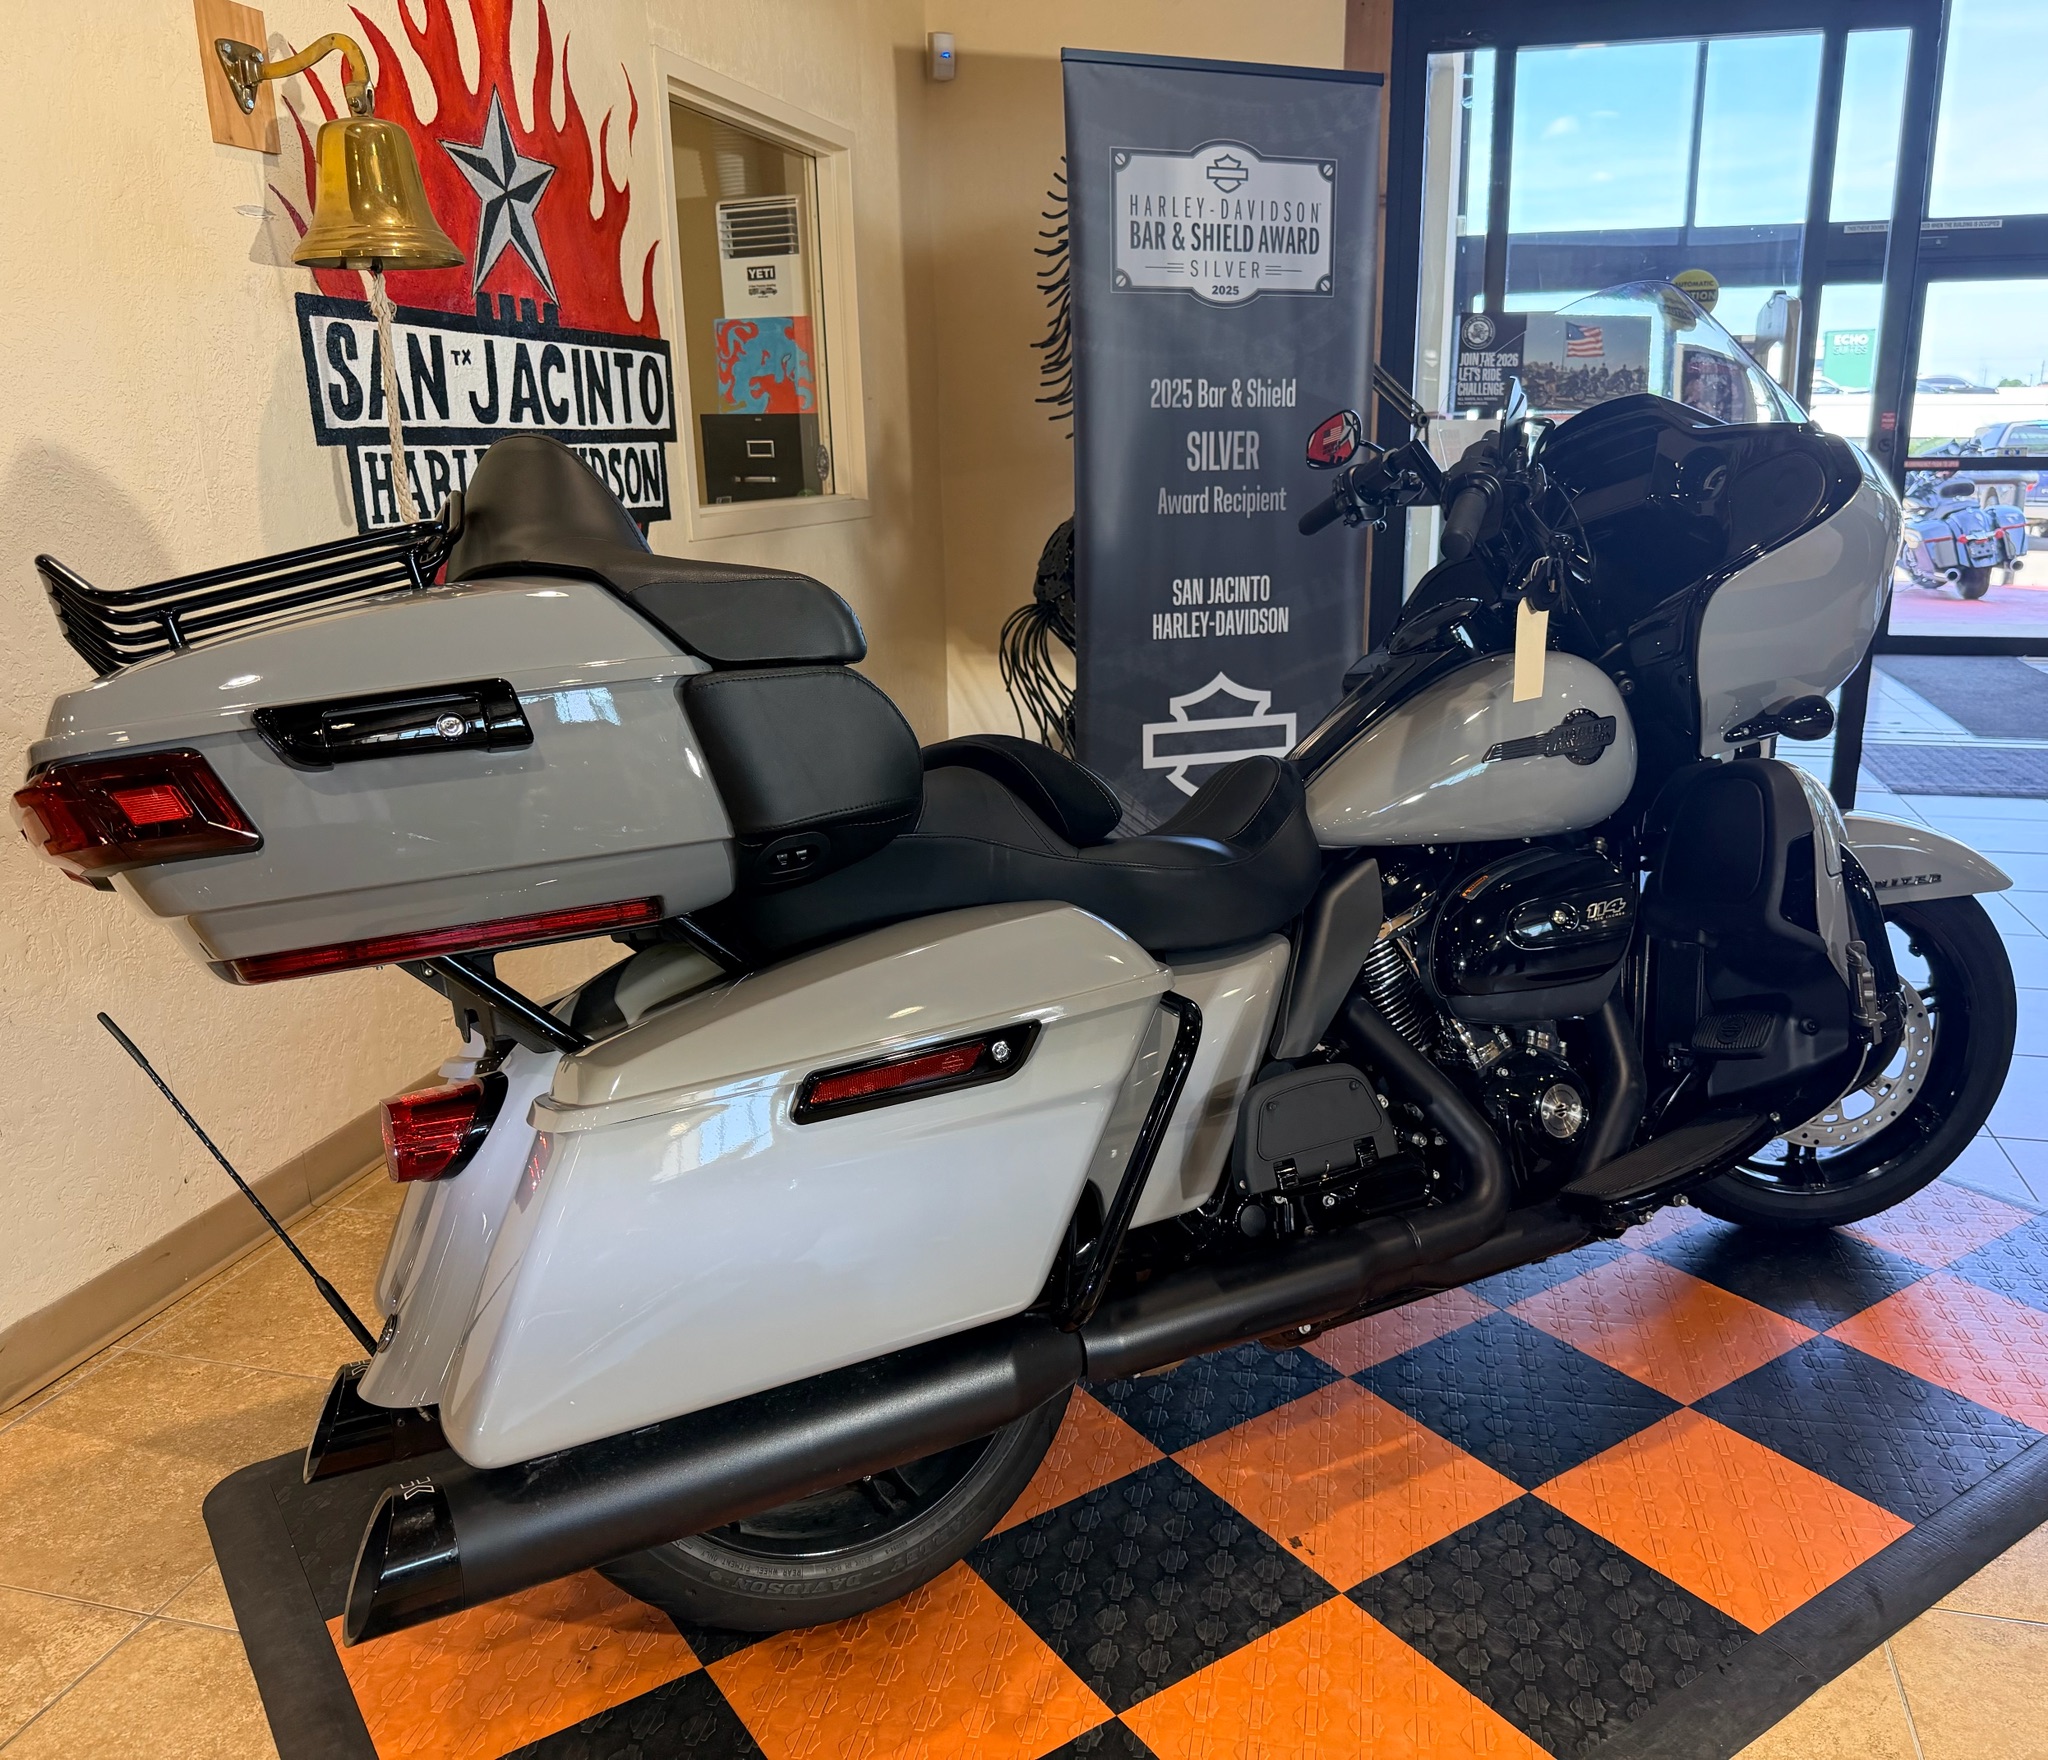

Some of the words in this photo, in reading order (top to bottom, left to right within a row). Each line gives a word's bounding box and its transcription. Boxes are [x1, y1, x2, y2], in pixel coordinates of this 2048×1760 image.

[1130, 194, 1320, 223] HARLEY-DAVIDSON
[1130, 220, 1166, 250] BAR
[1172, 221, 1186, 251] &
[1190, 222, 1254, 253] SHIELD
[1258, 225, 1320, 255] AWARD
[748, 268, 774, 279] YETI
[1190, 259, 1260, 278] SILVER
[1211, 285, 1240, 295] 2025
[1675, 280, 1715, 288] AUTOMATIC
[1687, 290, 1717, 301] TION
[1833, 333, 1869, 346] ECHO
[1459, 352, 1480, 366] JOIN
[1480, 352, 1496, 367] THE
[1496, 353, 1519, 367] 2026
[326, 321, 450, 422] SAN
[450, 349, 471, 366] TX
[468, 339, 665, 426] JACINTO
[1458, 367, 1481, 381] LET'S
[1482, 368, 1502, 382] RIDE
[1150, 378, 1193, 409] 2025
[1197, 378, 1227, 409] Bar
[1231, 378, 1243, 408] &
[1246, 377, 1297, 408] Shield
[1457, 382, 1505, 396] CHALLENGE
[1186, 430, 1260, 472] SILVER
[1157, 486, 1209, 515] Award
[1213, 485, 1287, 518] Recipient
[1172, 578, 1204, 606] SAN
[1207, 575, 1270, 604] JACINTO
[1152, 606, 1289, 640] HARLEY-DAVIDSON
[1585, 897, 1627, 919] 114
[701, 1551, 719, 1562] ONLY
[721, 1558, 750, 1572] FITMENT
[756, 1565, 778, 1576] WHEEL
[782, 1569, 801, 1577] REAR
[732, 1573, 862, 1594] DAVIDSON
